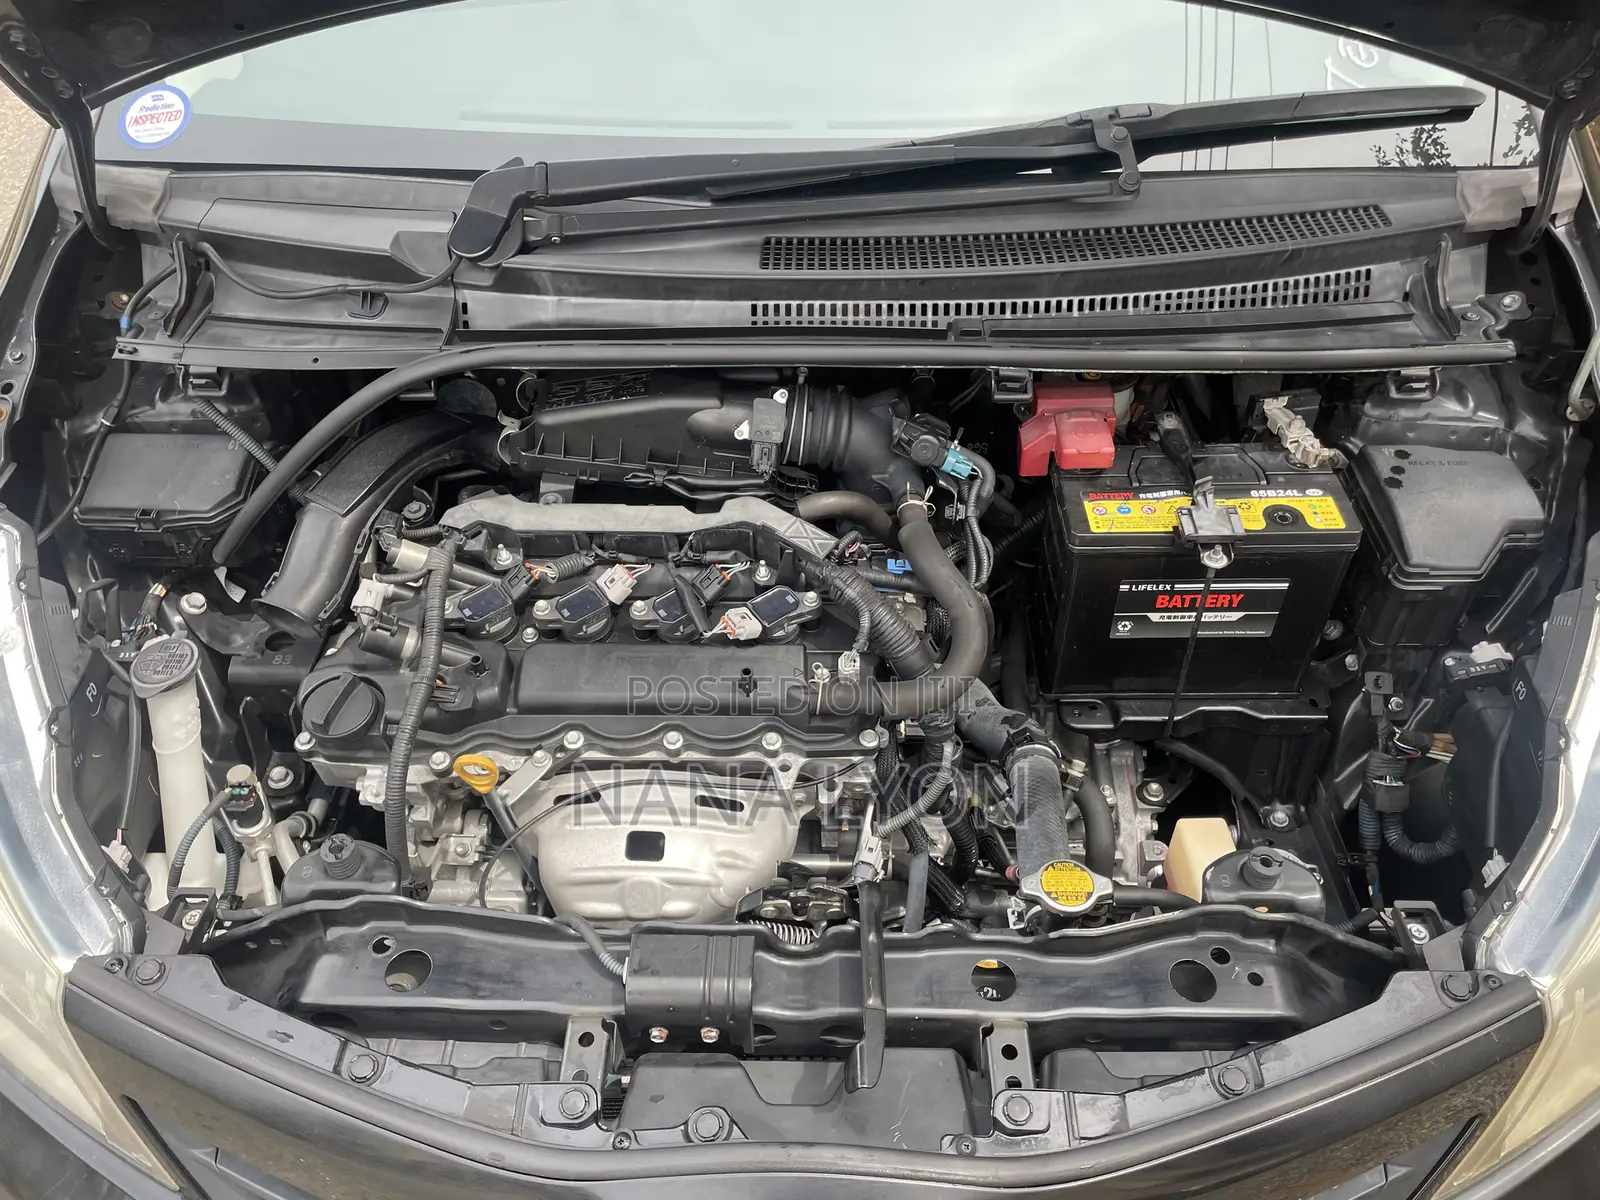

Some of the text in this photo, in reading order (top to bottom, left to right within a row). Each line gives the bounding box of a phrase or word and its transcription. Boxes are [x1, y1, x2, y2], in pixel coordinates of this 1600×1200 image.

[127, 109, 183, 128] INSPECTED
[1088, 492, 1134, 500] BATTERY
[1250, 489, 1303, 497] 65B24L
[1155, 594, 1245, 608] BATTERY
